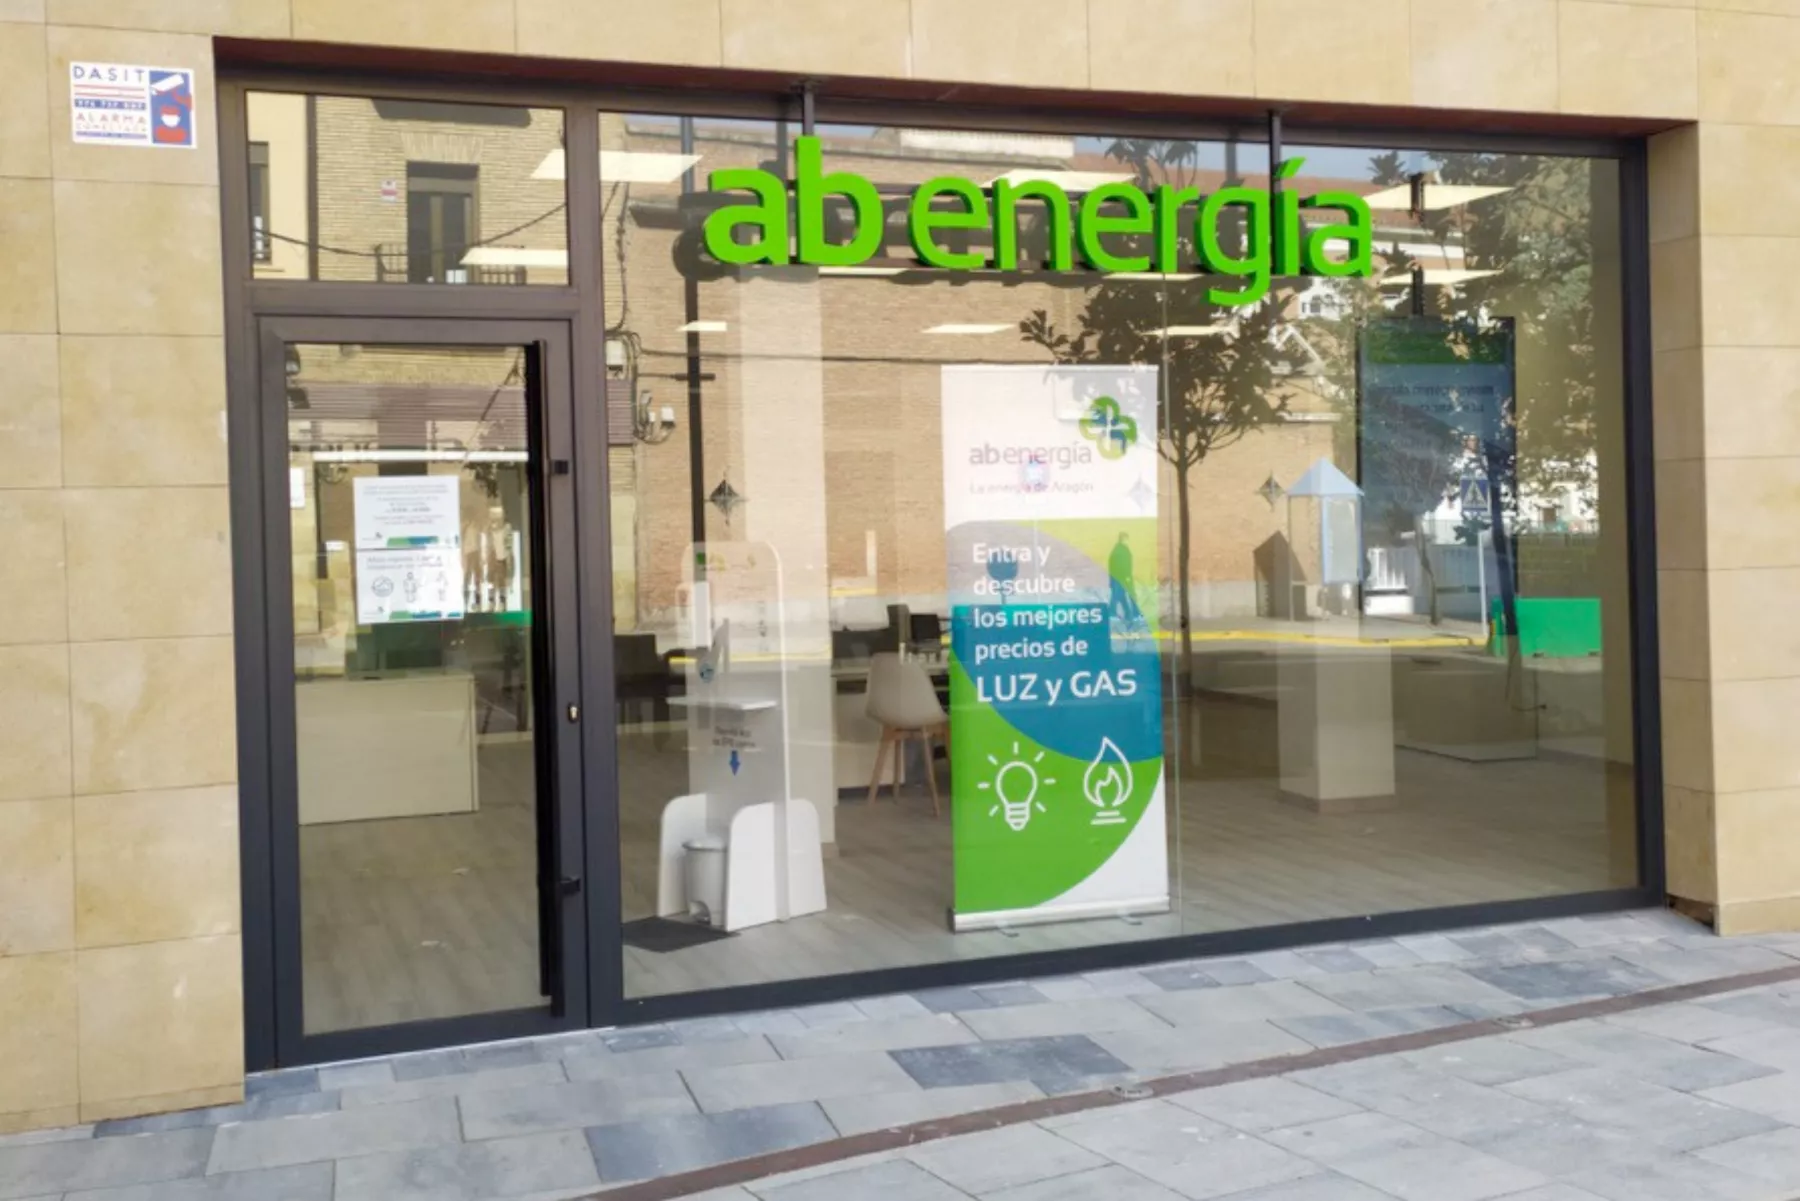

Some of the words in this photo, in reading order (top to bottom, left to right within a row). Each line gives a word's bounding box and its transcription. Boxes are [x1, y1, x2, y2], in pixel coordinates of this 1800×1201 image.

[73, 65, 144, 82] DASIT
[76, 113, 146, 124] ALARMA
[970, 481, 985, 494] La
[989, 479, 1031, 496] energía
[1034, 480, 1049, 493] de
[1052, 479, 1094, 495] Aragón
[972, 543, 1031, 563] Entra
[1038, 546, 1050, 565] y
[973, 574, 1075, 595] descubre
[974, 608, 1007, 628] los
[1013, 606, 1102, 629] mejores
[975, 637, 1055, 665] precios
[1061, 636, 1088, 656] de
[976, 674, 1038, 702] LUZ
[1045, 677, 1062, 705] y
[1070, 670, 1136, 698] GAS
